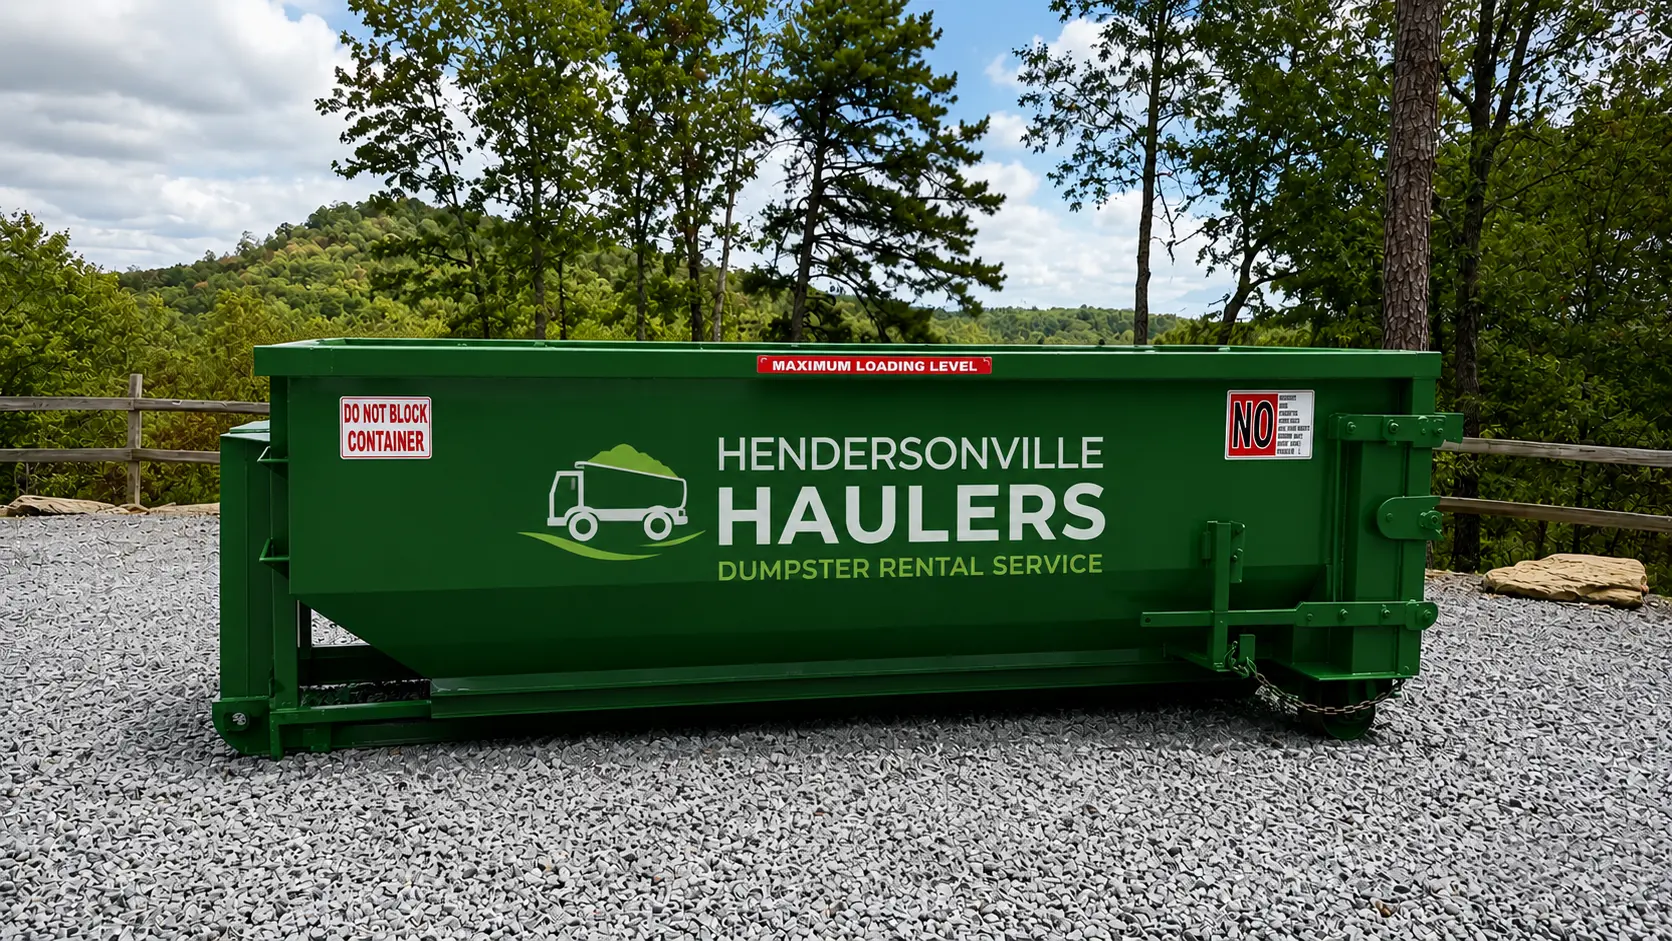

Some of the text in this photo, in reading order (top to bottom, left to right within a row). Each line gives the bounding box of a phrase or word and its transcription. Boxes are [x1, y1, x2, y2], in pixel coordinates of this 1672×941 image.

[772, 360, 978, 372] MAXIMUM LOADING LEVEL
[344, 403, 428, 424] DO NOT BLOCK
[1232, 399, 1275, 449] NO
[348, 430, 425, 452] CONTAINER
[718, 436, 1104, 471] HENDERSONVILLE
[718, 483, 1106, 545] HAULERS
[718, 554, 1103, 581] DUMPSTER RENTAL SERVICE
